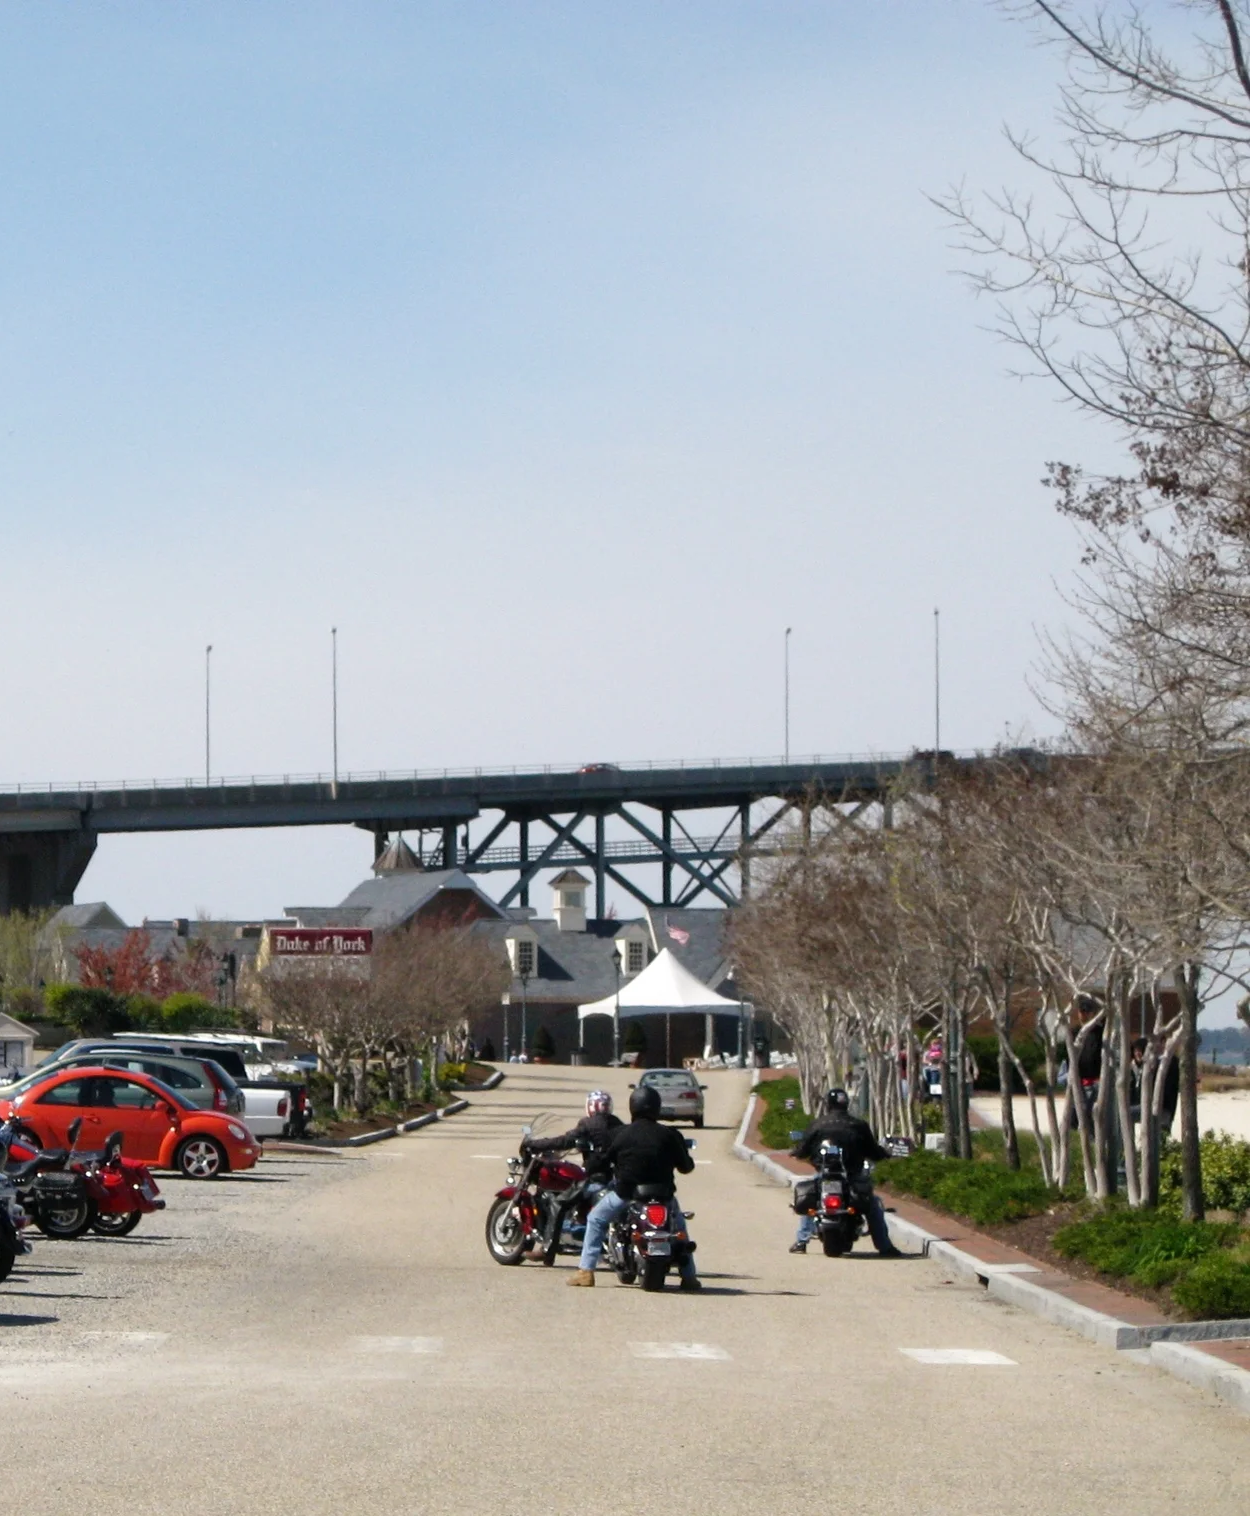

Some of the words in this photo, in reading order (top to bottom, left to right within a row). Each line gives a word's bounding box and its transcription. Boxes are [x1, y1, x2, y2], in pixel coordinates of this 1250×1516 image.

[276, 936, 310, 951] Duke
[314, 936, 330, 951] of
[333, 935, 366, 954] York
